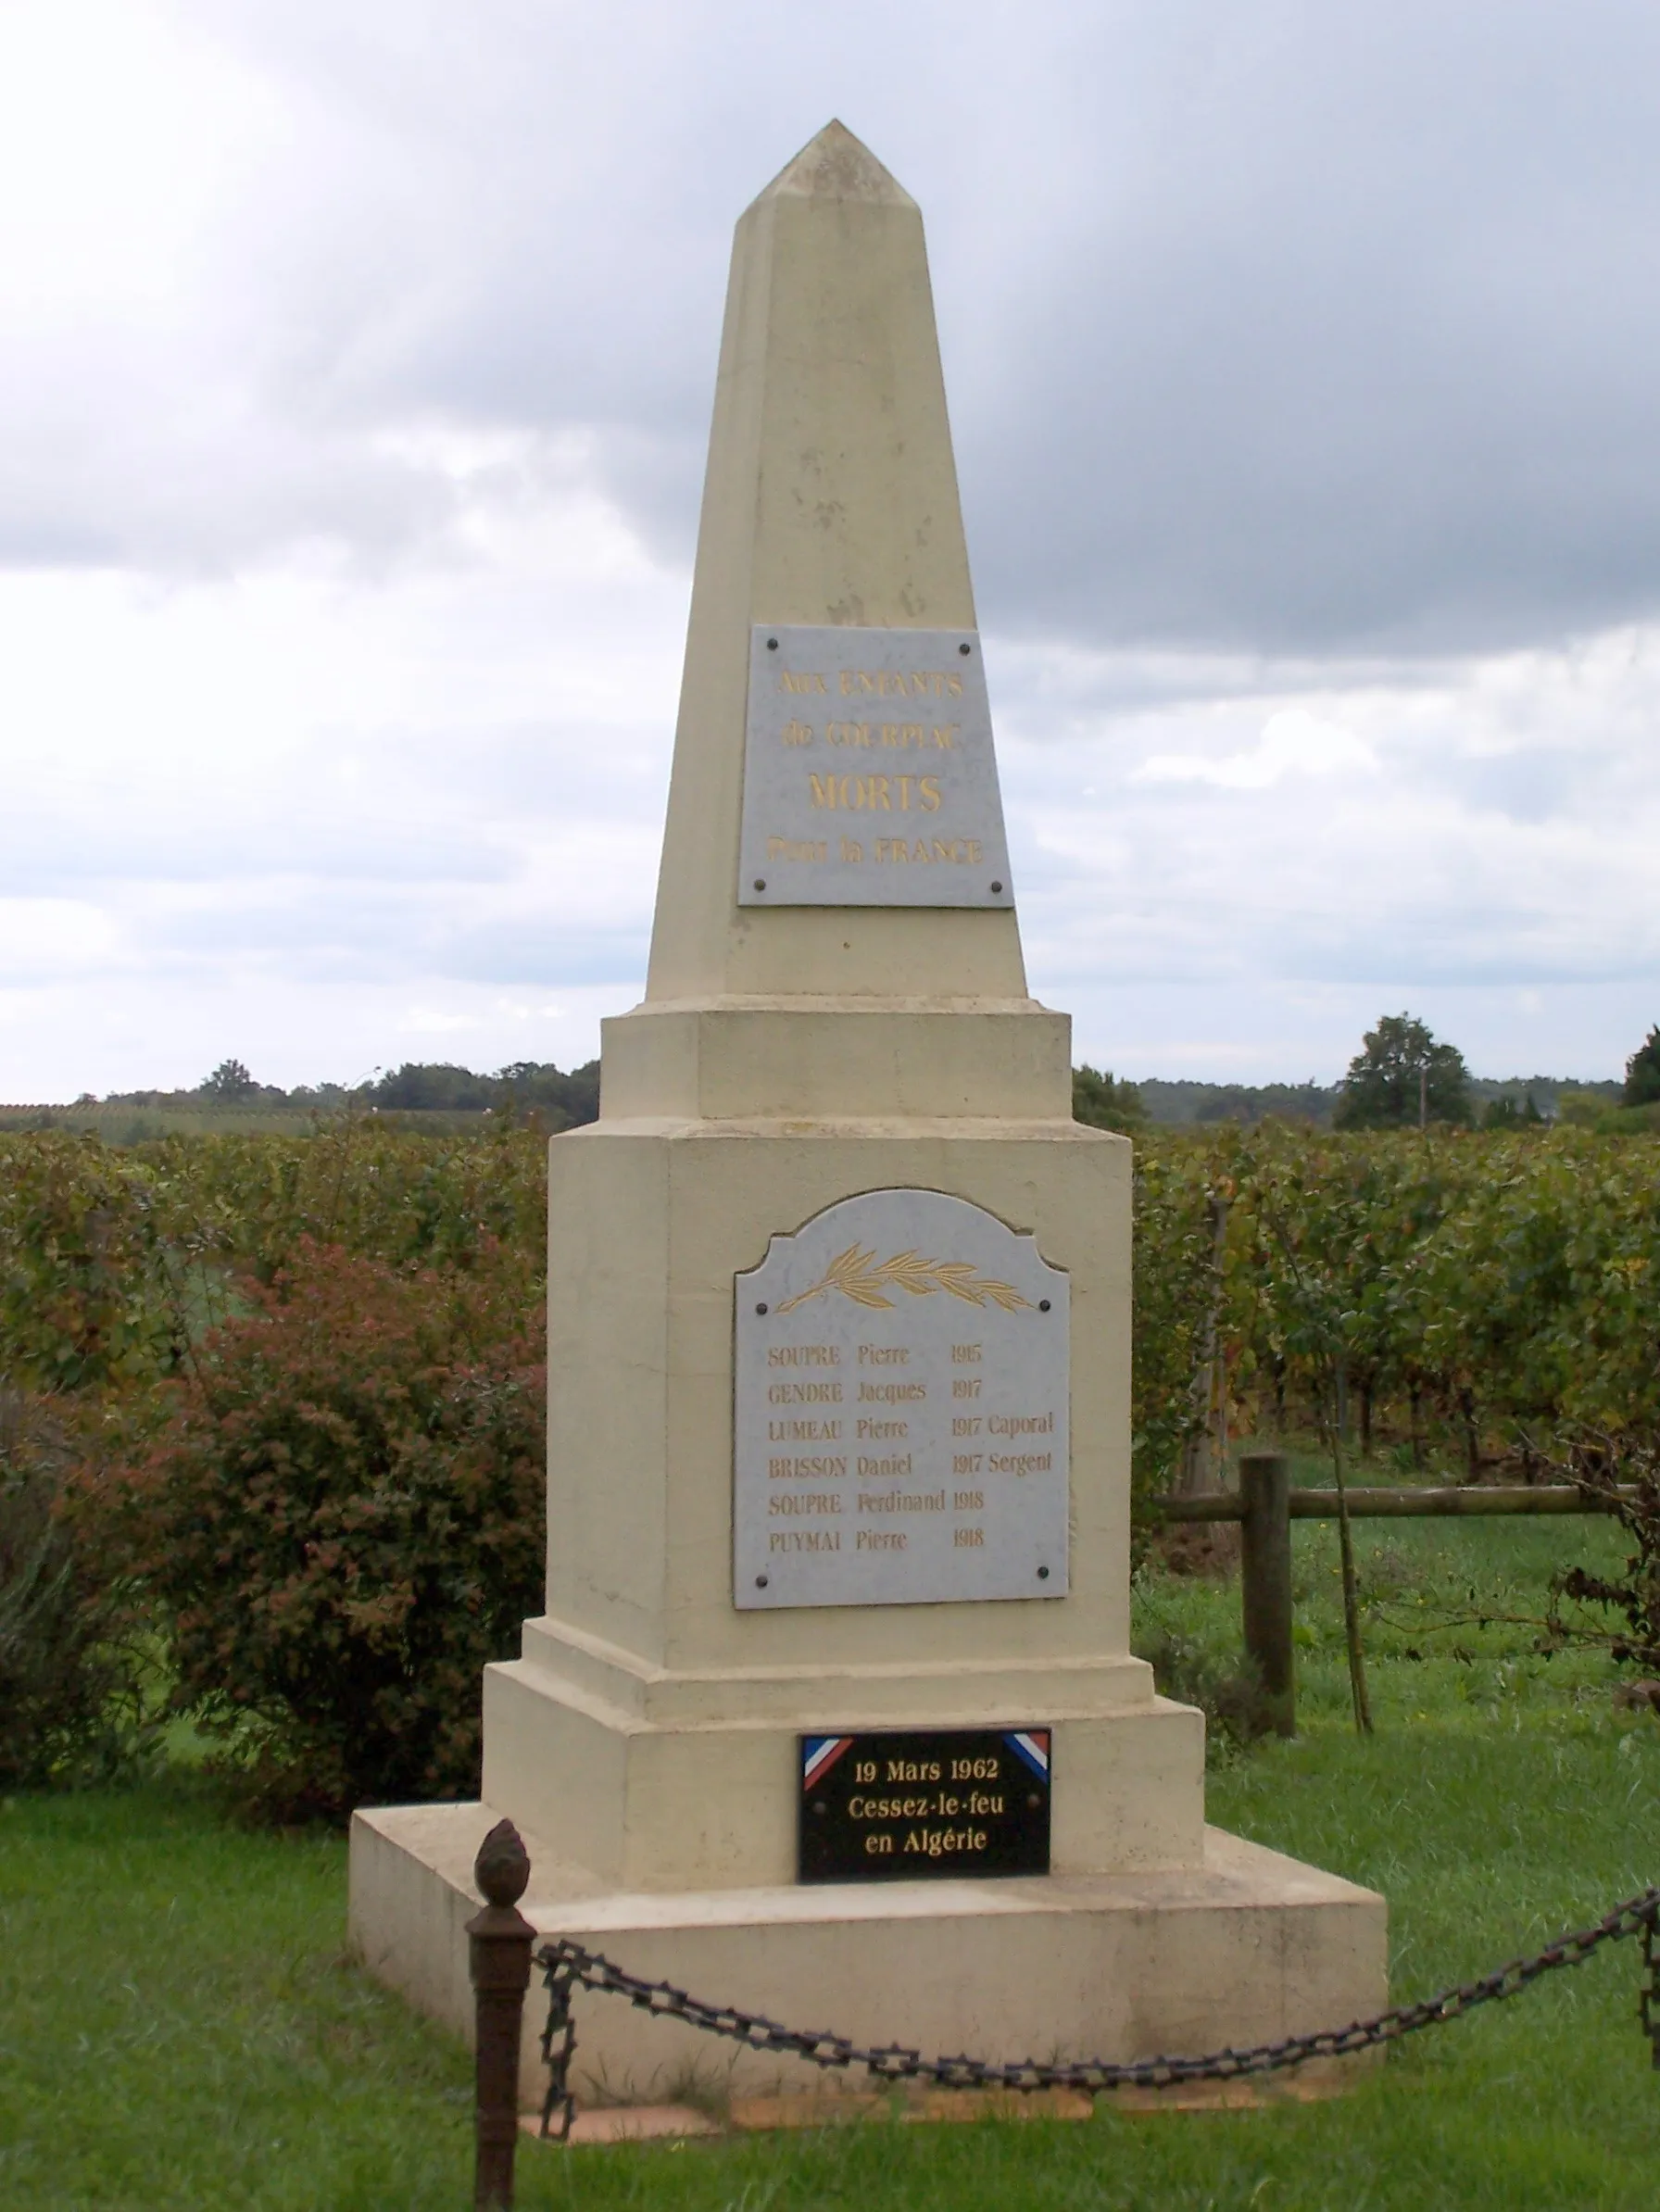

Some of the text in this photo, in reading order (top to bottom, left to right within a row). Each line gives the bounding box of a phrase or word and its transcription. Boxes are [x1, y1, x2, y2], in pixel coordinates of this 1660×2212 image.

[838, 671, 963, 697] ENFANTS
[781, 718, 815, 747] de
[809, 773, 941, 812] MORTS
[840, 836, 863, 863] la
[874, 837, 983, 864] FRANCE
[768, 1343, 982, 1367] SOUPRE Pierre 1915
[768, 1379, 982, 1405] GENDRE Jacques 1917
[769, 1412, 1054, 1441] LUMEAU Pierre 1917 Caporal
[768, 1452, 1052, 1479] BRISSON Daniel 1917 Sergent
[768, 1489, 984, 1516] SOUPRE Ferdinand 1918
[857, 1530, 907, 1552] Pierre
[952, 1527, 984, 1549] 1918
[855, 1759, 1000, 1782] 19 Mars 1962
[864, 1827, 987, 1856] en Algérie
